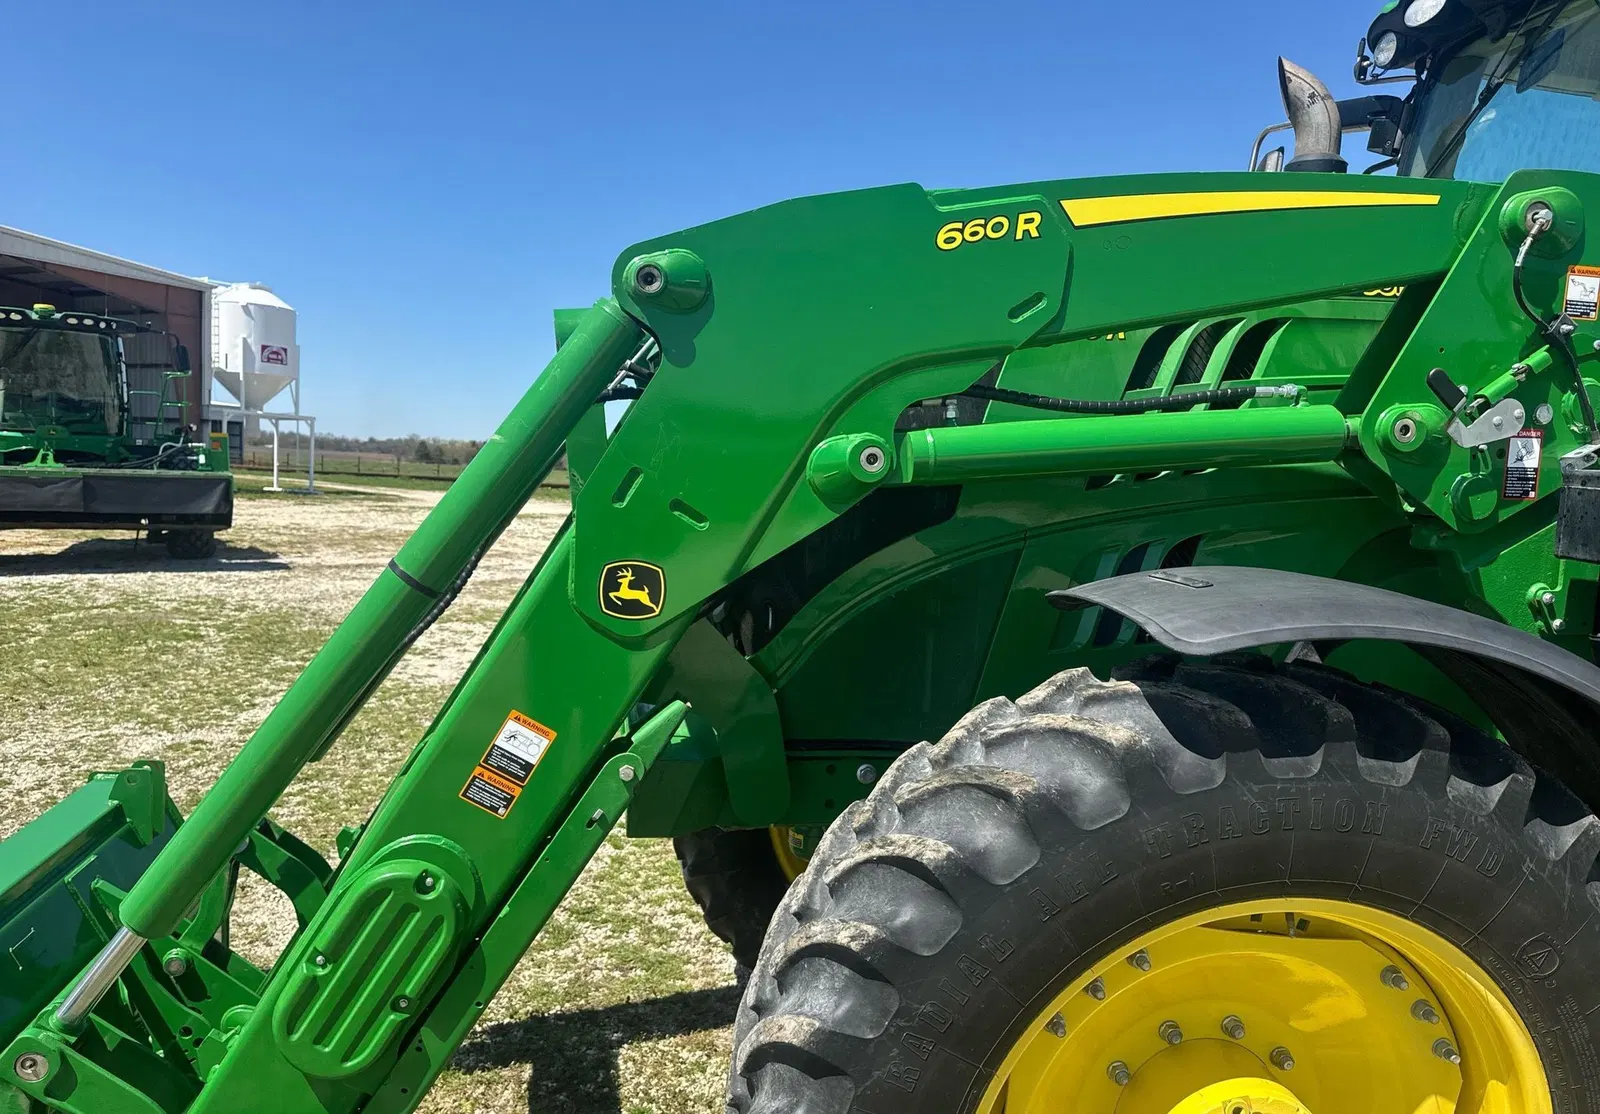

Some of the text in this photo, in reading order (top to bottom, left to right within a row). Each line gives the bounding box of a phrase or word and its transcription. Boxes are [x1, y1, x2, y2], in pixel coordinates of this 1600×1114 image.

[521, 718, 551, 738] WARNING
[486, 774, 516, 794] WARNING
[884, 795, 1506, 1094] RADIAL ALL TRACTION FWD
